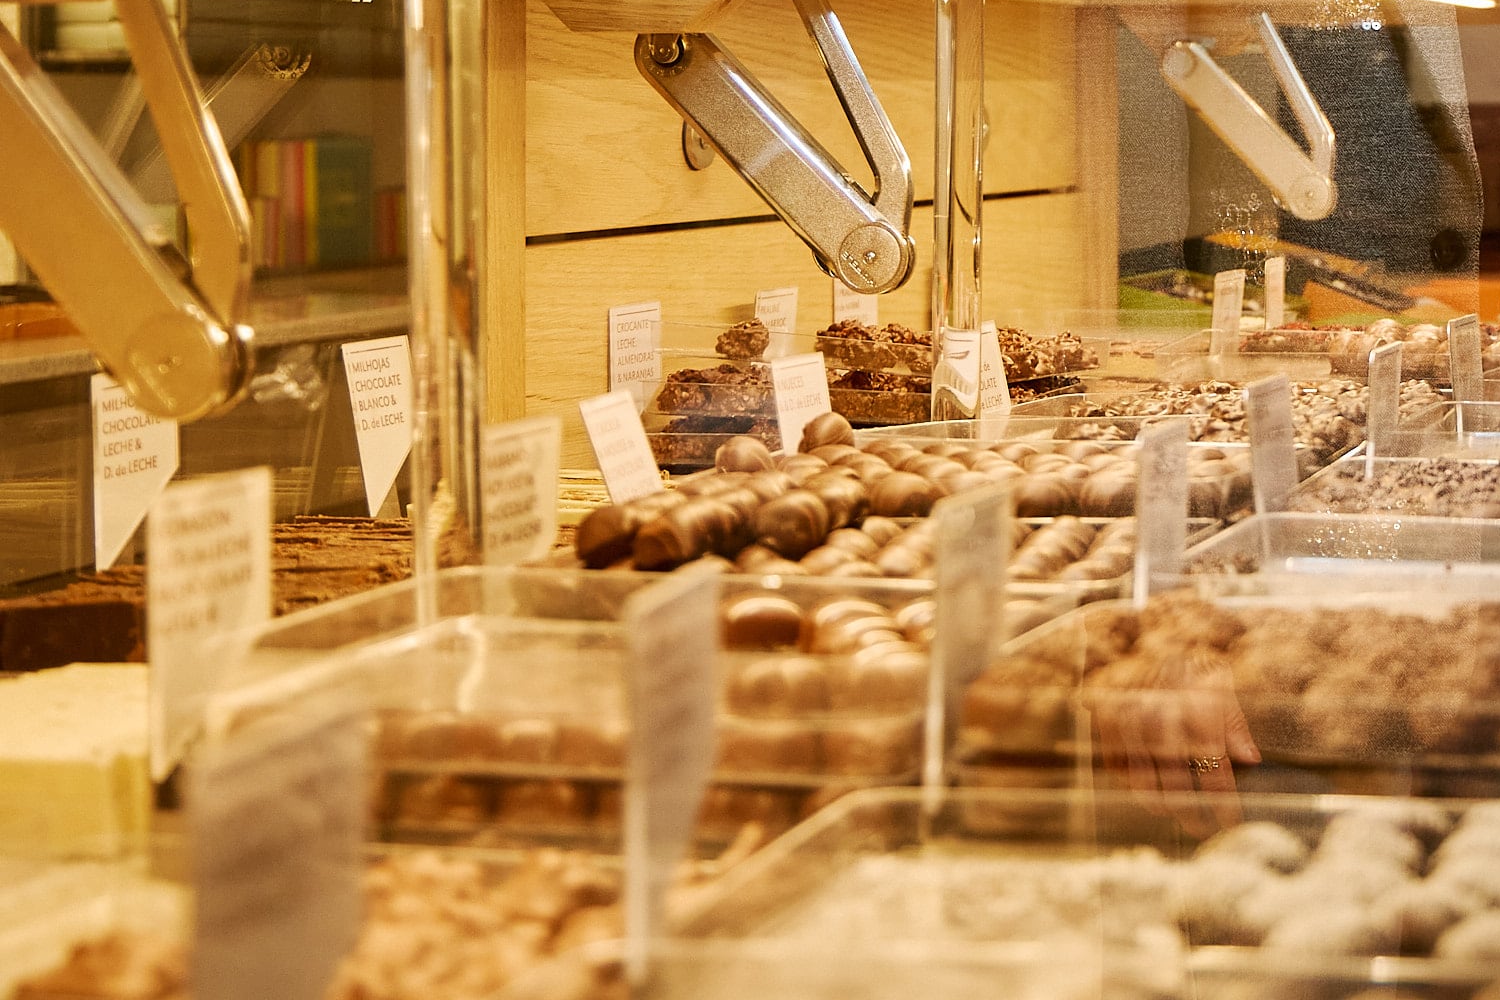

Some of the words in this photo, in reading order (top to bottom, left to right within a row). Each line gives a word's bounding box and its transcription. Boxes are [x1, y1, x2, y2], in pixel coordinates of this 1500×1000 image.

[617, 319, 649, 333] CROCANTE
[617, 337, 636, 350] LECHE
[352, 357, 390, 372] MILHOJAS
[617, 351, 654, 366] ALMENDRAS
[355, 374, 402, 392] CHOCOLATE
[102, 396, 135, 412] MILHO
[359, 395, 390, 411] BLANCO
[381, 412, 405, 427] LECHE
[103, 439, 133, 457] LECHE
[128, 456, 158, 473] LECHE
